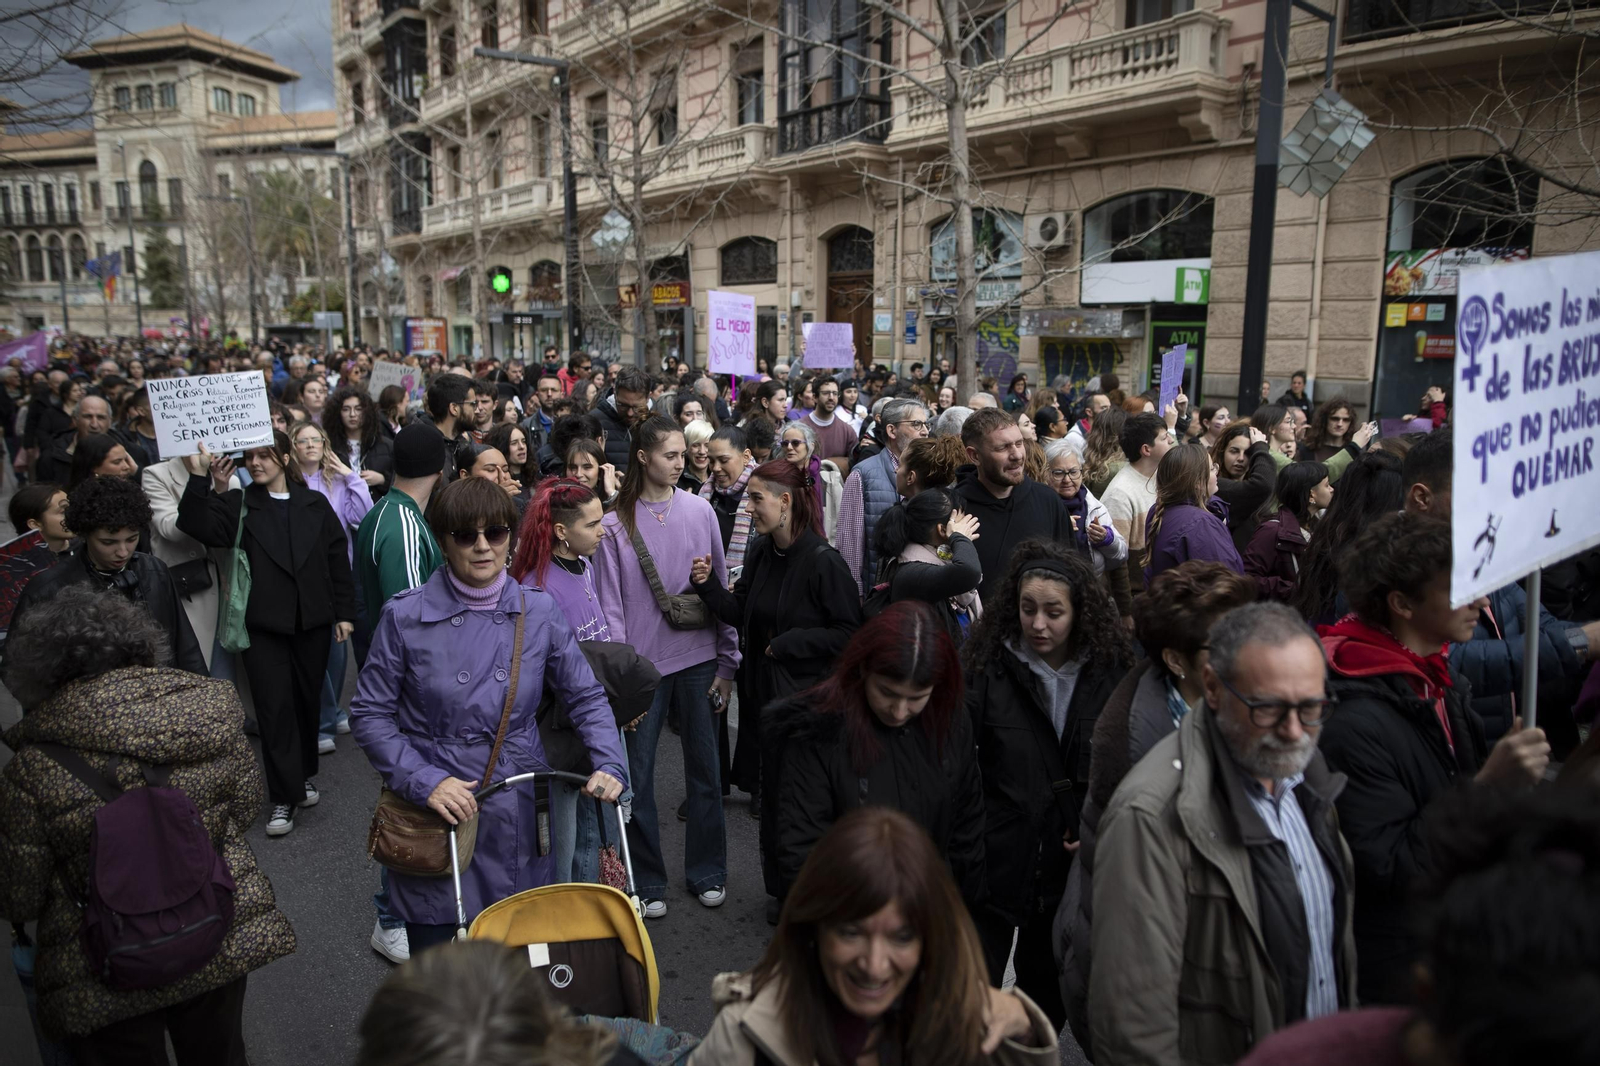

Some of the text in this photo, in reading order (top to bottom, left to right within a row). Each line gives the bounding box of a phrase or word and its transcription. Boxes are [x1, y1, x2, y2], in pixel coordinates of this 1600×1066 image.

[1184, 281, 1202, 291] ATM
[1560, 288, 1582, 328] las
[716, 318, 751, 333] EL MIEDO
[1169, 331, 1199, 345] ATM
[1486, 353, 1511, 403] de
[1523, 343, 1553, 394] las
[150, 379, 191, 394] NUNCA
[212, 403, 256, 414] DERECHOS
[208, 412, 250, 424] MUJERES
[173, 428, 209, 442] SEAN
[221, 440, 230, 449] de
[1472, 422, 1512, 485] que
[1520, 412, 1541, 446] no
[1513, 436, 1594, 499] QUEMAR
